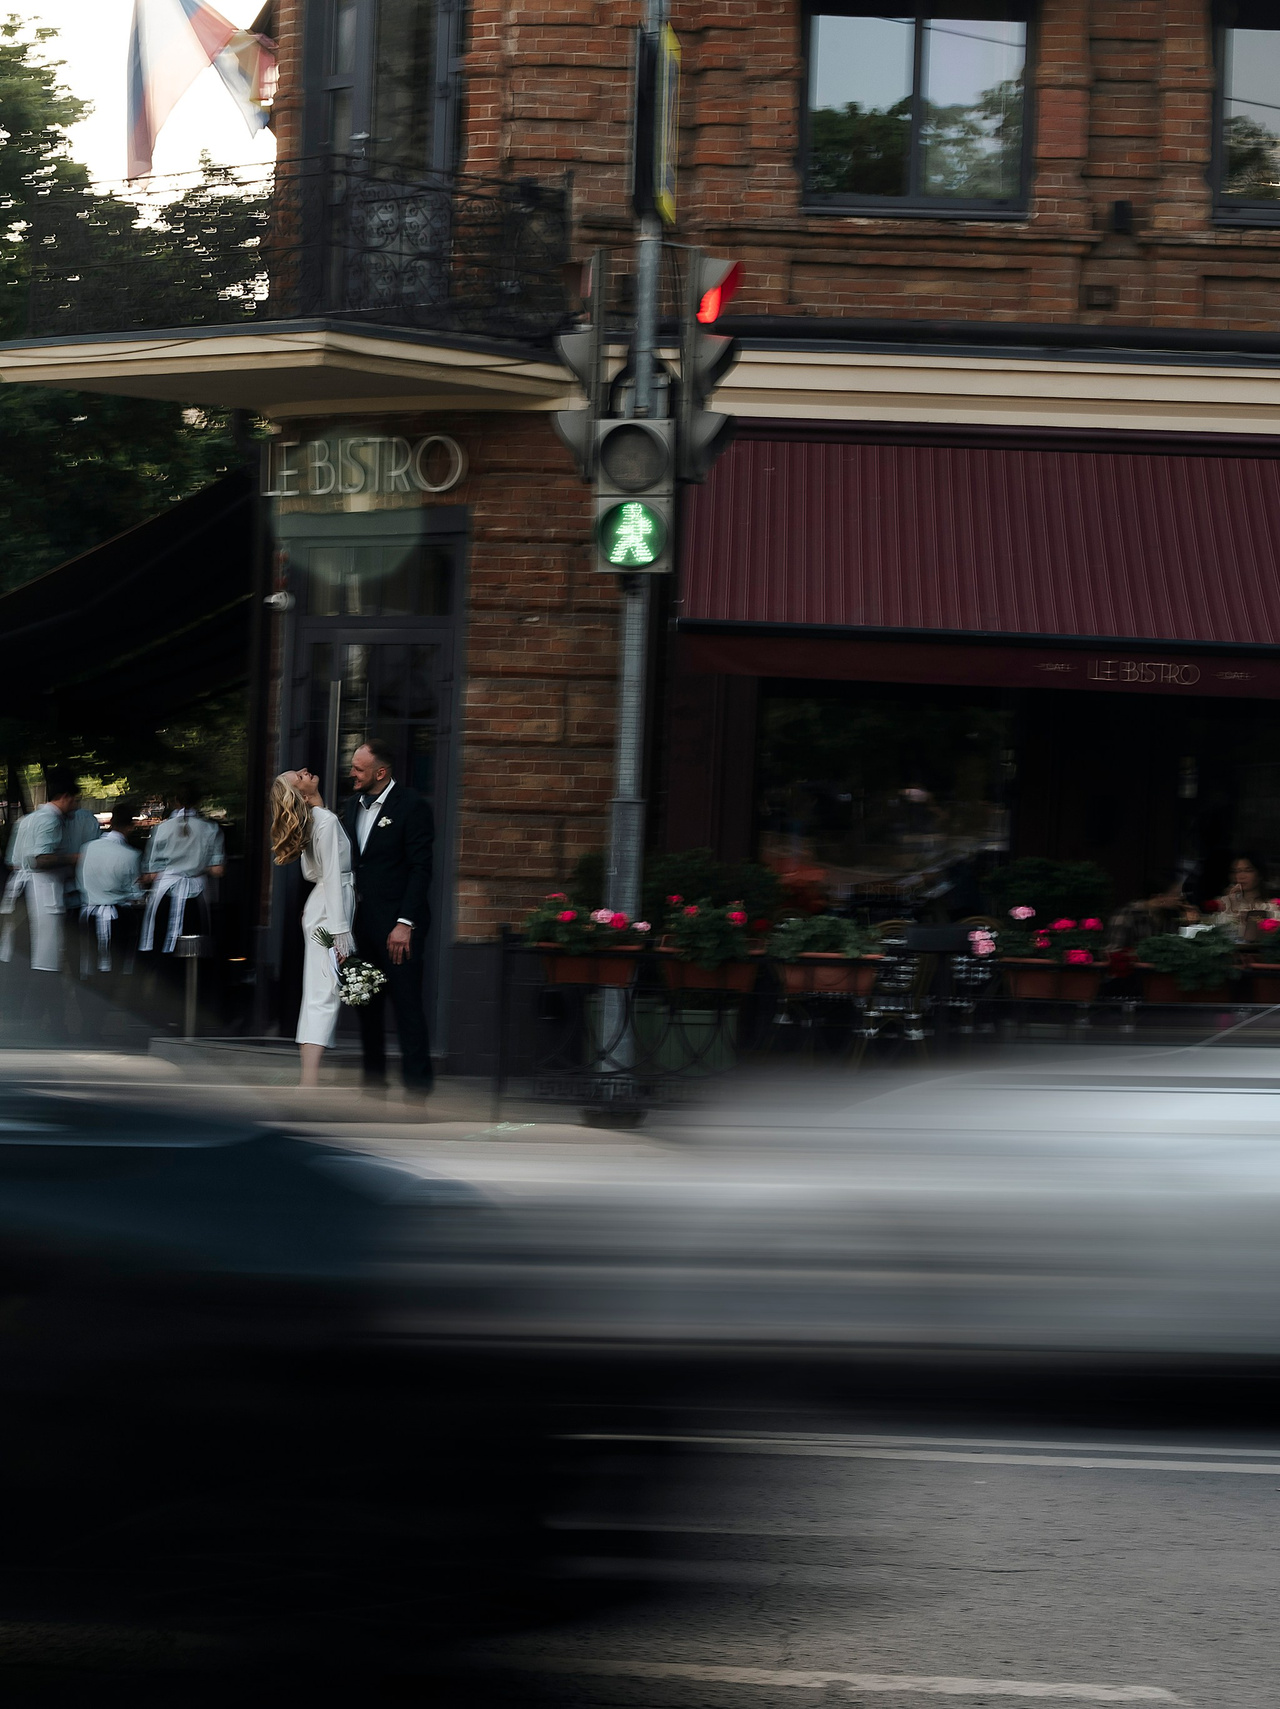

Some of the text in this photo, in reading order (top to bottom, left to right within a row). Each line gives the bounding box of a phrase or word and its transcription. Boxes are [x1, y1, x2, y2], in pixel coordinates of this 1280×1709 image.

[261, 435, 468, 497] LE BISTRO
[1088, 659, 1201, 686] LE BISTRO
